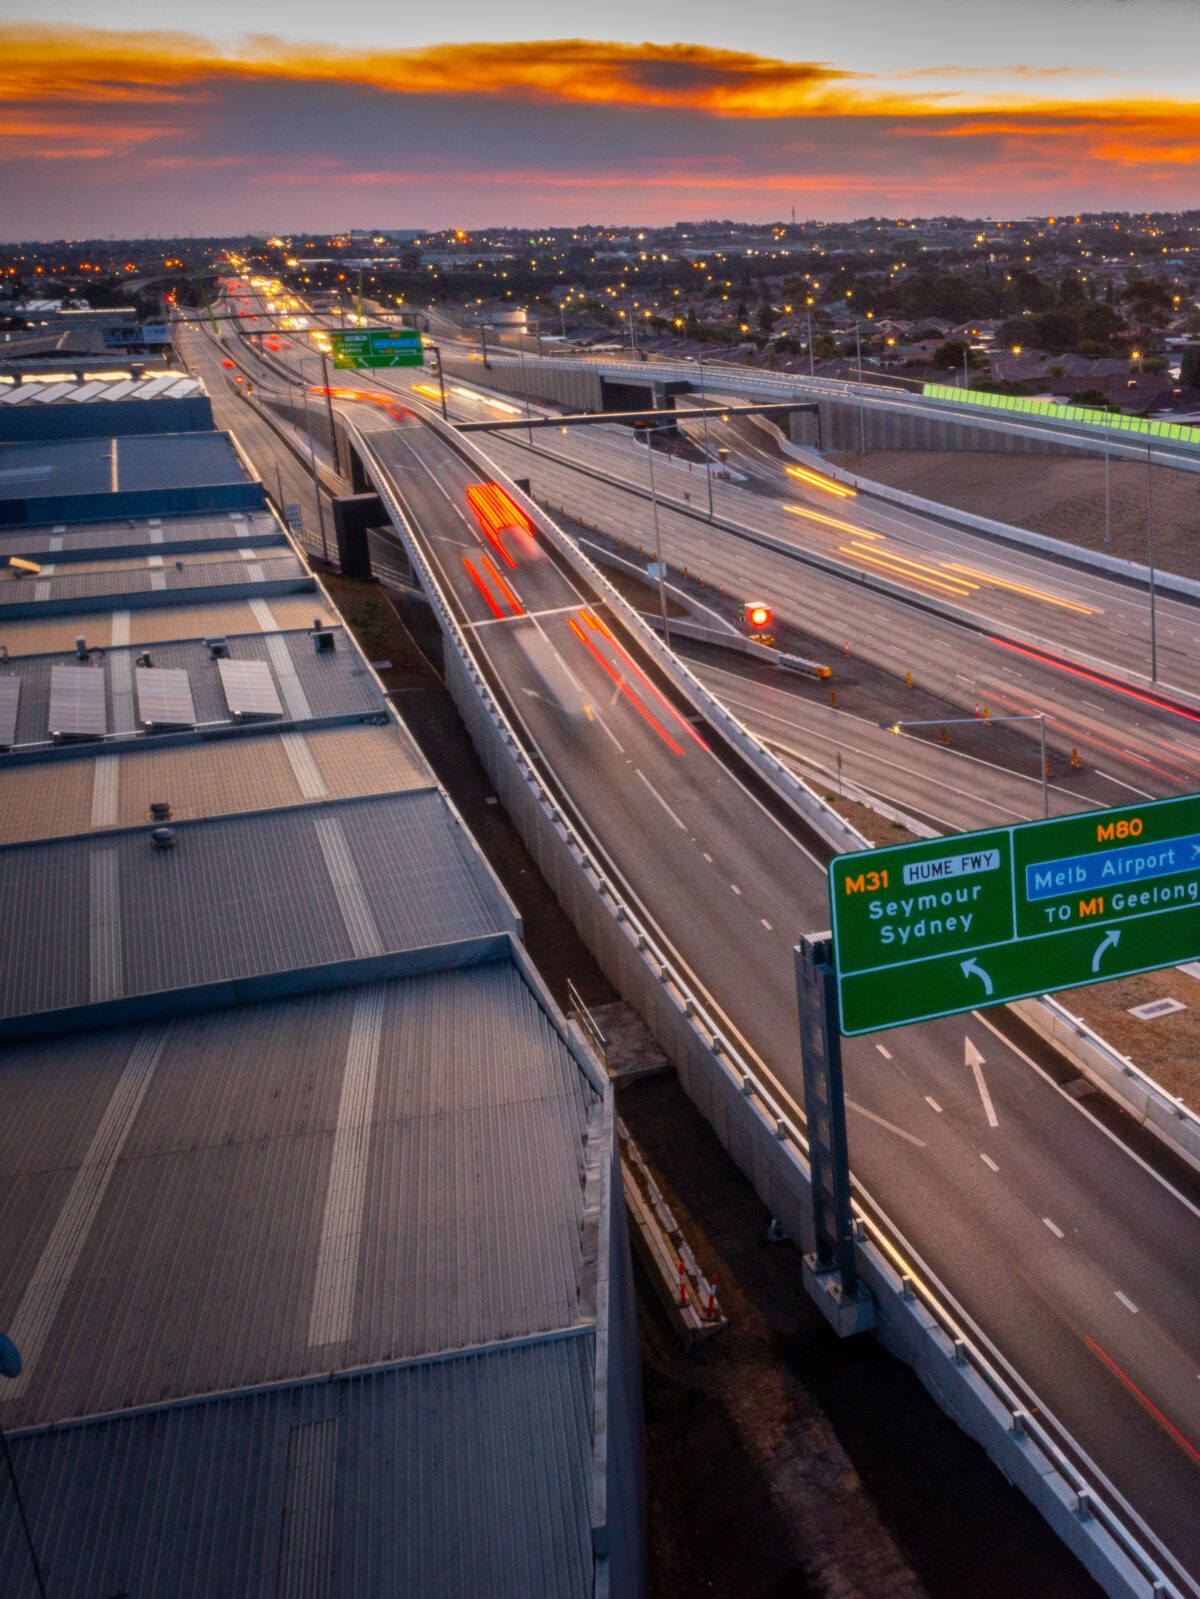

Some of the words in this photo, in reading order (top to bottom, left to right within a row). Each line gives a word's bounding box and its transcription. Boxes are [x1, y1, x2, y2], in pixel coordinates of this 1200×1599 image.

[1097, 817, 1143, 842] M80
[845, 870, 889, 895] M31
[909, 860, 953, 881] HUME
[961, 853, 994, 871] FWY
[1035, 866, 1087, 890] Melb
[1101, 849, 1176, 878] Airport
[869, 886, 982, 920] Seymour
[1044, 905, 1071, 923] TO
[1079, 897, 1104, 918] M1
[1111, 882, 1198, 911] Geelong
[880, 913, 973, 945] Sydney
